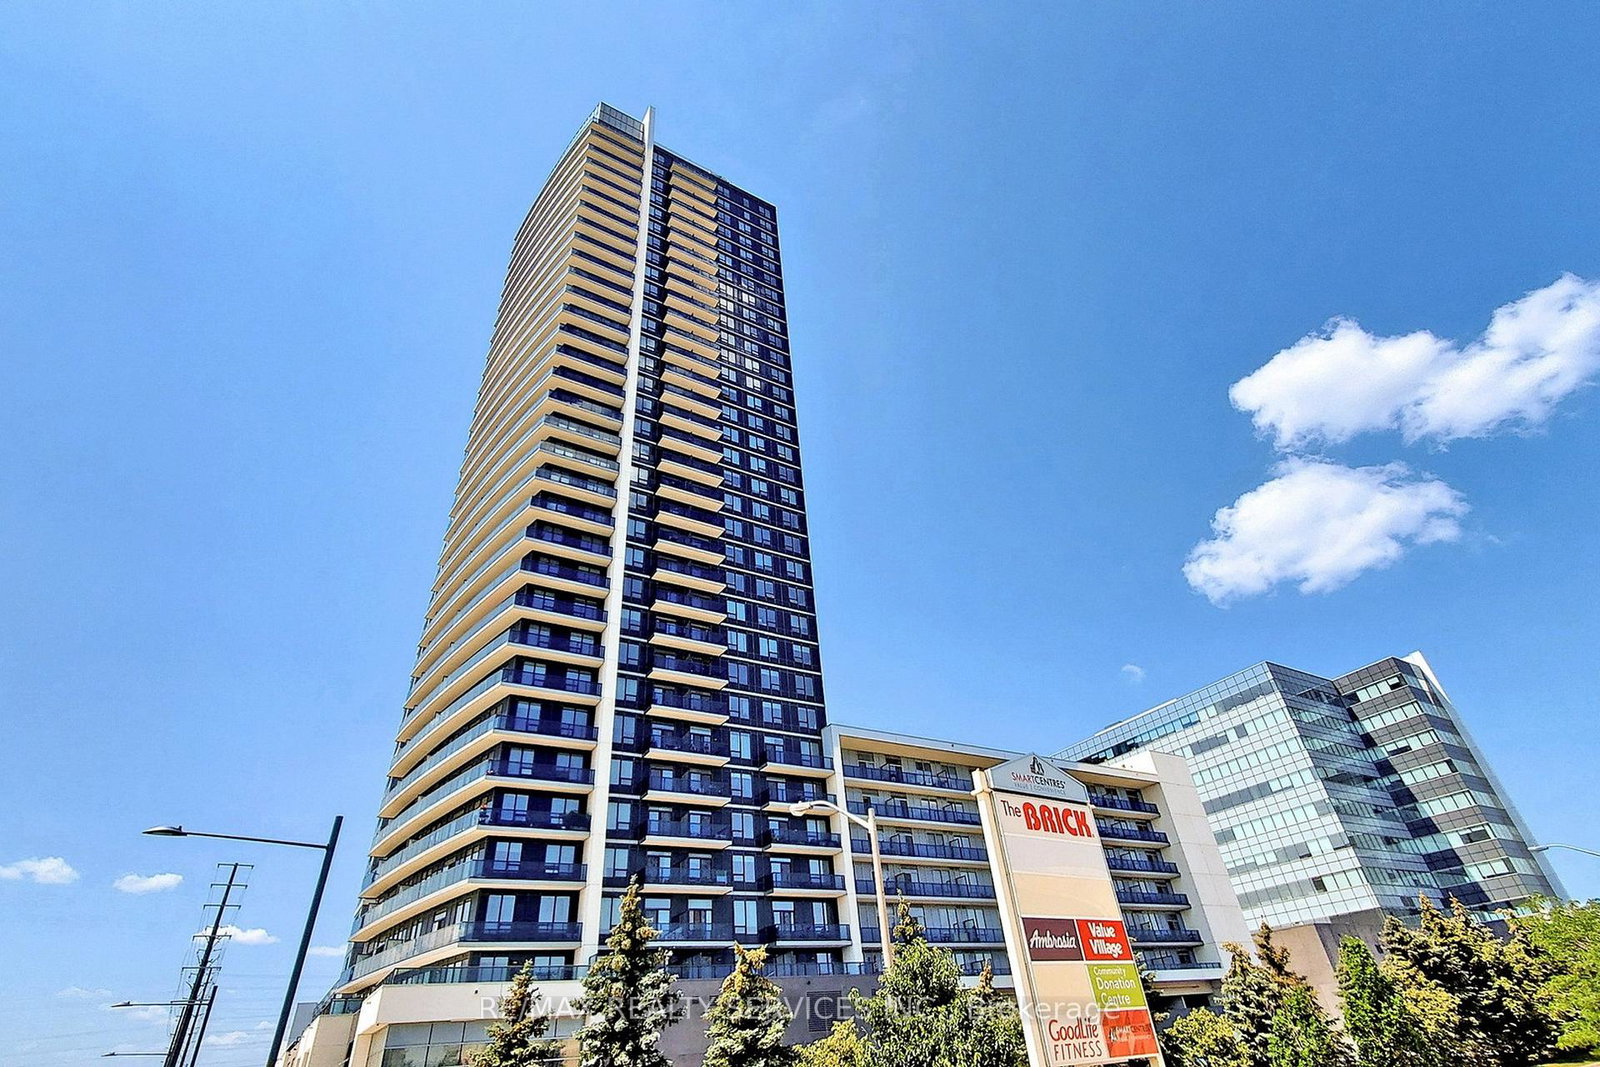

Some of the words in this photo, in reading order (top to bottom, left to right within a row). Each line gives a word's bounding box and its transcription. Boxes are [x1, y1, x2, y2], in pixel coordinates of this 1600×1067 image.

[1011, 771, 1065, 789] SMARTCENTRES
[1001, 800, 1021, 817] The
[1022, 802, 1091, 838] BRICK
[1030, 927, 1077, 949] Ambrosia
[1088, 922, 1115, 938] Value
[1089, 939, 1123, 958] Village
[1093, 966, 1126, 977] Community
[1096, 977, 1136, 991] Donation
[1101, 993, 1130, 1006] Centre
[1048, 1016, 1098, 1042] GoodLife
[1054, 1041, 1102, 1061] FITNESS
